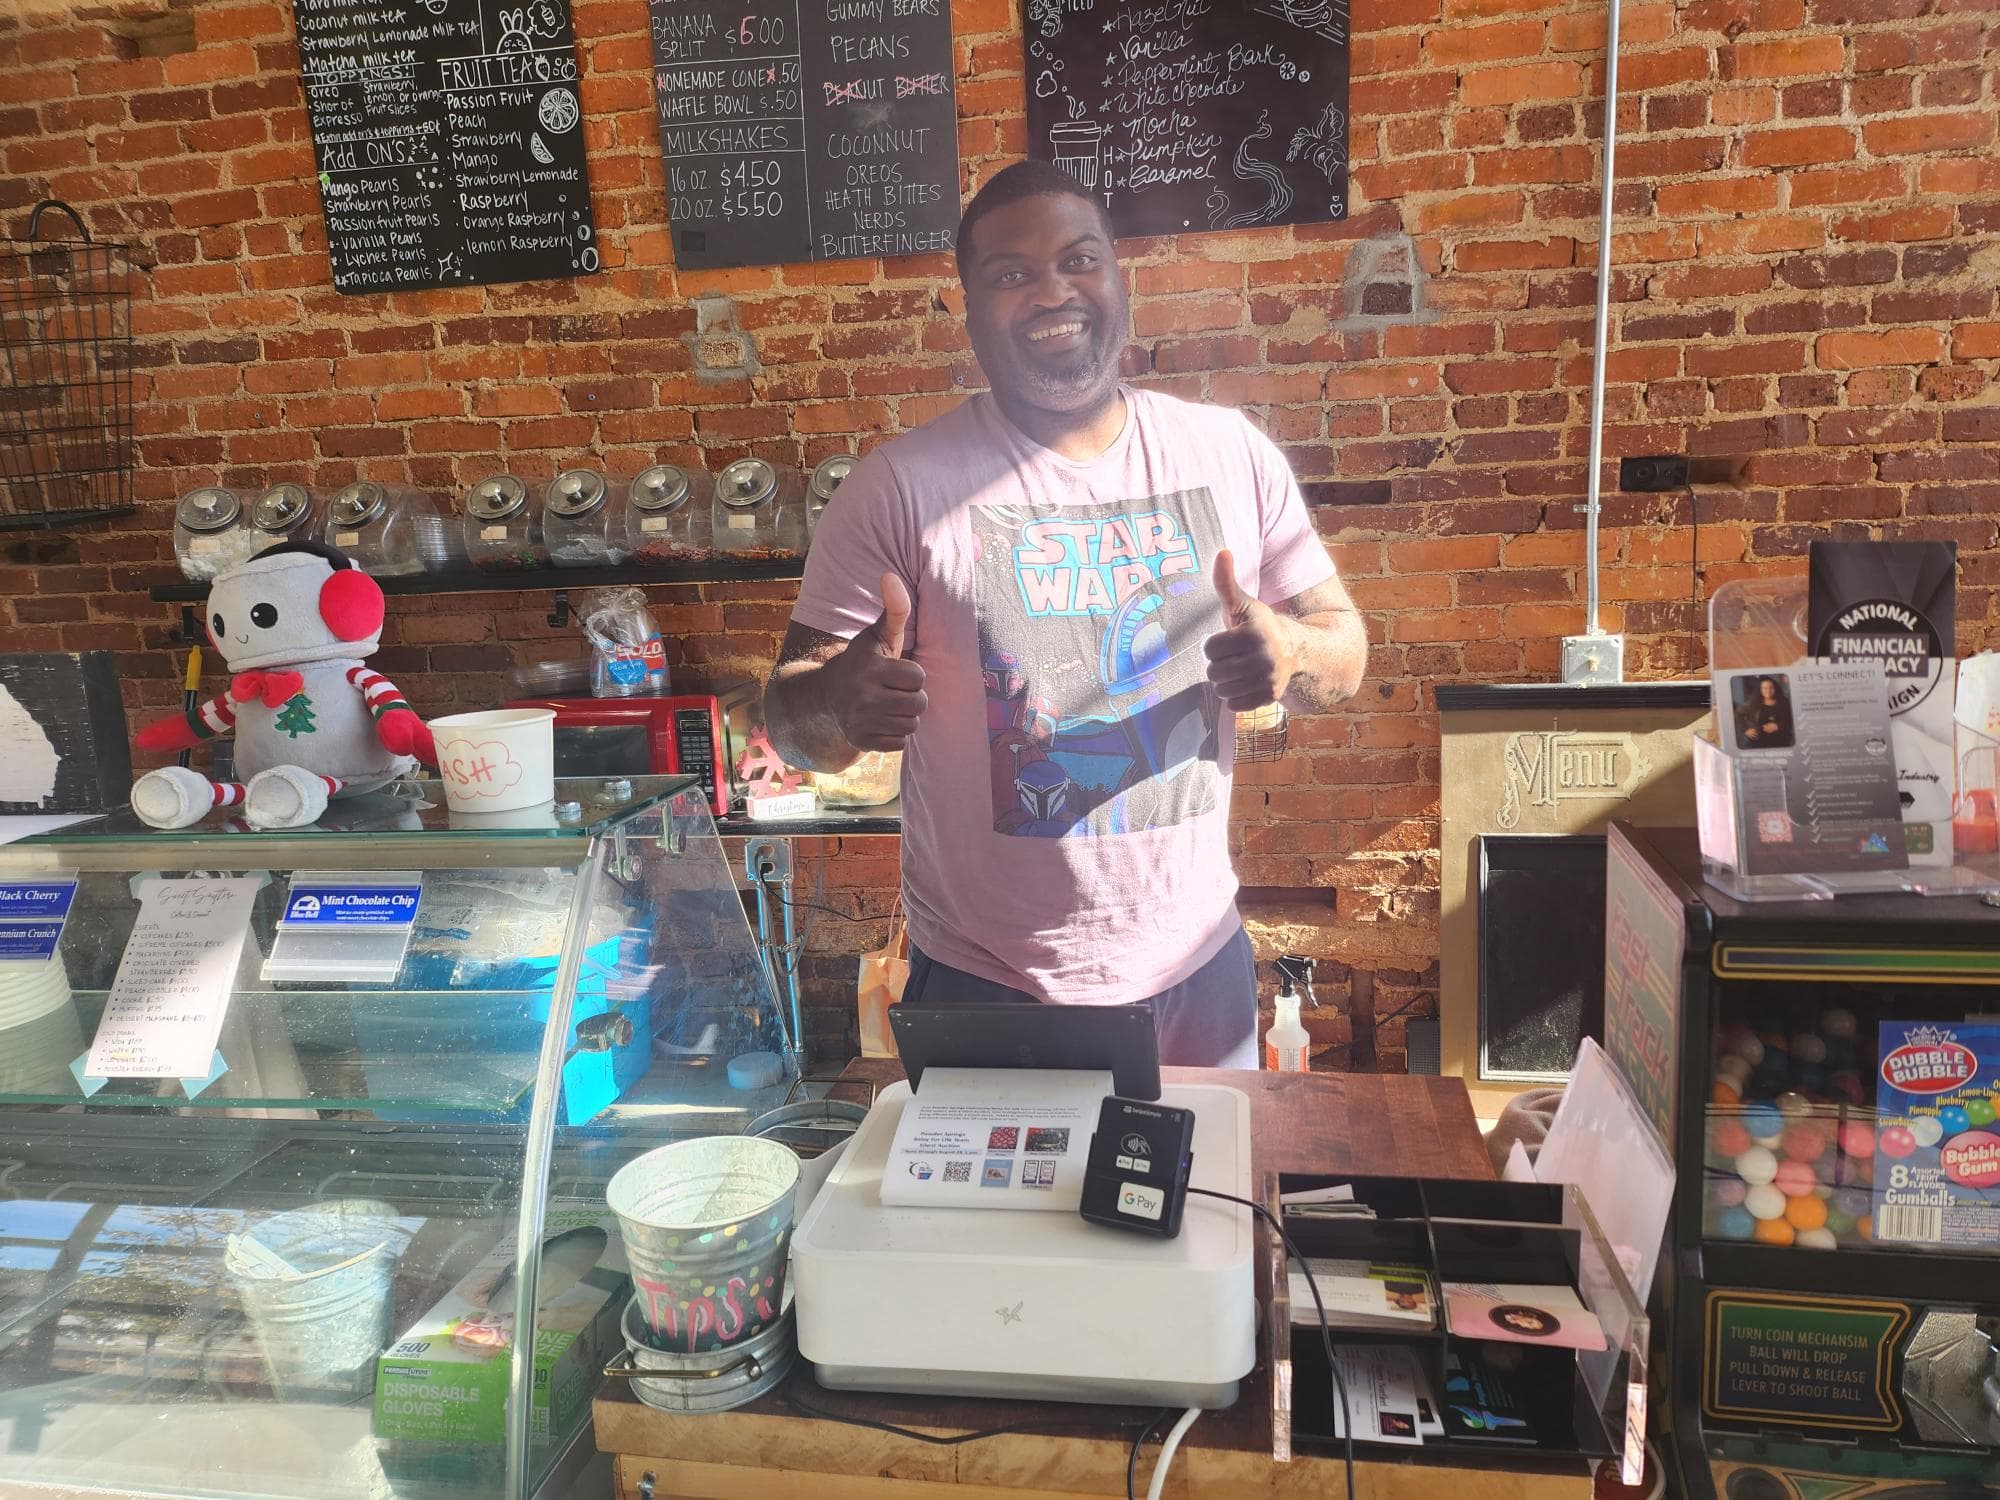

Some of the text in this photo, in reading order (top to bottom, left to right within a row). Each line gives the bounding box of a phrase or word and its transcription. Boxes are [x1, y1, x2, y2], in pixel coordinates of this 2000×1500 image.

[826, 0, 940, 23] GUMMY BEARS
[301, 16, 349, 31] Coconut
[651, 14, 717, 40] BANANA
[302, 31, 369, 51] Strawberry
[373, 25, 429, 43] Lemonade
[830, 34, 911, 63] PECANS
[1119, 30, 1194, 60] Vanilla
[660, 40, 706, 59] SPLIT
[309, 53, 358, 73] Matcha
[440, 56, 534, 90] FRUIT TEA
[1118, 42, 1286, 87] Peppermint Bark
[732, 68, 766, 88] CONE
[447, 88, 534, 110] Passion Fruit
[659, 95, 707, 119] WAFFLE
[714, 94, 755, 115] BOWL
[449, 113, 487, 130] Peach
[452, 130, 523, 150] Strawberry
[667, 125, 789, 153] MILKSHAKES
[321, 143, 357, 170] Add
[452, 151, 498, 173] Mango
[456, 166, 579, 188] Strawberry Lemonade
[671, 166, 686, 192] 16
[720, 160, 781, 194] $4.50
[846, 162, 903, 185] OREOS
[321, 177, 400, 202] Mango Pearls
[825, 187, 871, 211] HEATH
[326, 192, 432, 214] Strawberry Pearls
[460, 190, 529, 212] Raspberry
[670, 196, 691, 220] 20
[721, 192, 783, 222] $5.50
[405, 213, 441, 228] Pearls
[507, 210, 565, 233] Raspberry
[853, 210, 906, 232] NERDS
[340, 231, 422, 251] Vanilla Pearls
[510, 233, 574, 256] Raspberry
[819, 229, 956, 257] BUTTERFINGER
[345, 248, 427, 268] Lychee Pearls
[395, 266, 433, 283] Pearls
[1016, 511, 1188, 566] STAR
[1839, 603, 1918, 631] NATIONAL
[1832, 637, 1926, 655] FINANCIAL
[1497, 725, 1618, 828] Menu
[1899, 769, 1941, 784] Industry
[0, 890, 61, 903] lack Cherry
[321, 895, 415, 908] Mint Chocolate Chip
[28, 928, 57, 938] Crunch
[1888, 1051, 1965, 1070] DUBBLE
[1892, 1064, 1968, 1083] BUBBLE
[1936, 1096, 1969, 1109] Blueberry
[1889, 1164, 1909, 1189] 8
[1910, 1166, 1946, 1176] Assorted
[1959, 1161, 1998, 1177] Gum
[1908, 1180, 1946, 1189] FLAVORS
[1124, 1192, 1157, 1212] G Pay
[1885, 1188, 1956, 1207] Gumballs
[1731, 1326, 1762, 1340] TURN
[1766, 1328, 1794, 1343] COIN
[396, 1343, 431, 1353] 500
[1749, 1345, 1847, 1364] BALL WILL DROP
[1730, 1361, 1866, 1384] PULL DOWN & RELEASE
[384, 1382, 480, 1402] DISPOSABLE
[1731, 1378, 1862, 1401] LEVER TO SHOOT BALL
[382, 1399, 444, 1417] GLOVES
